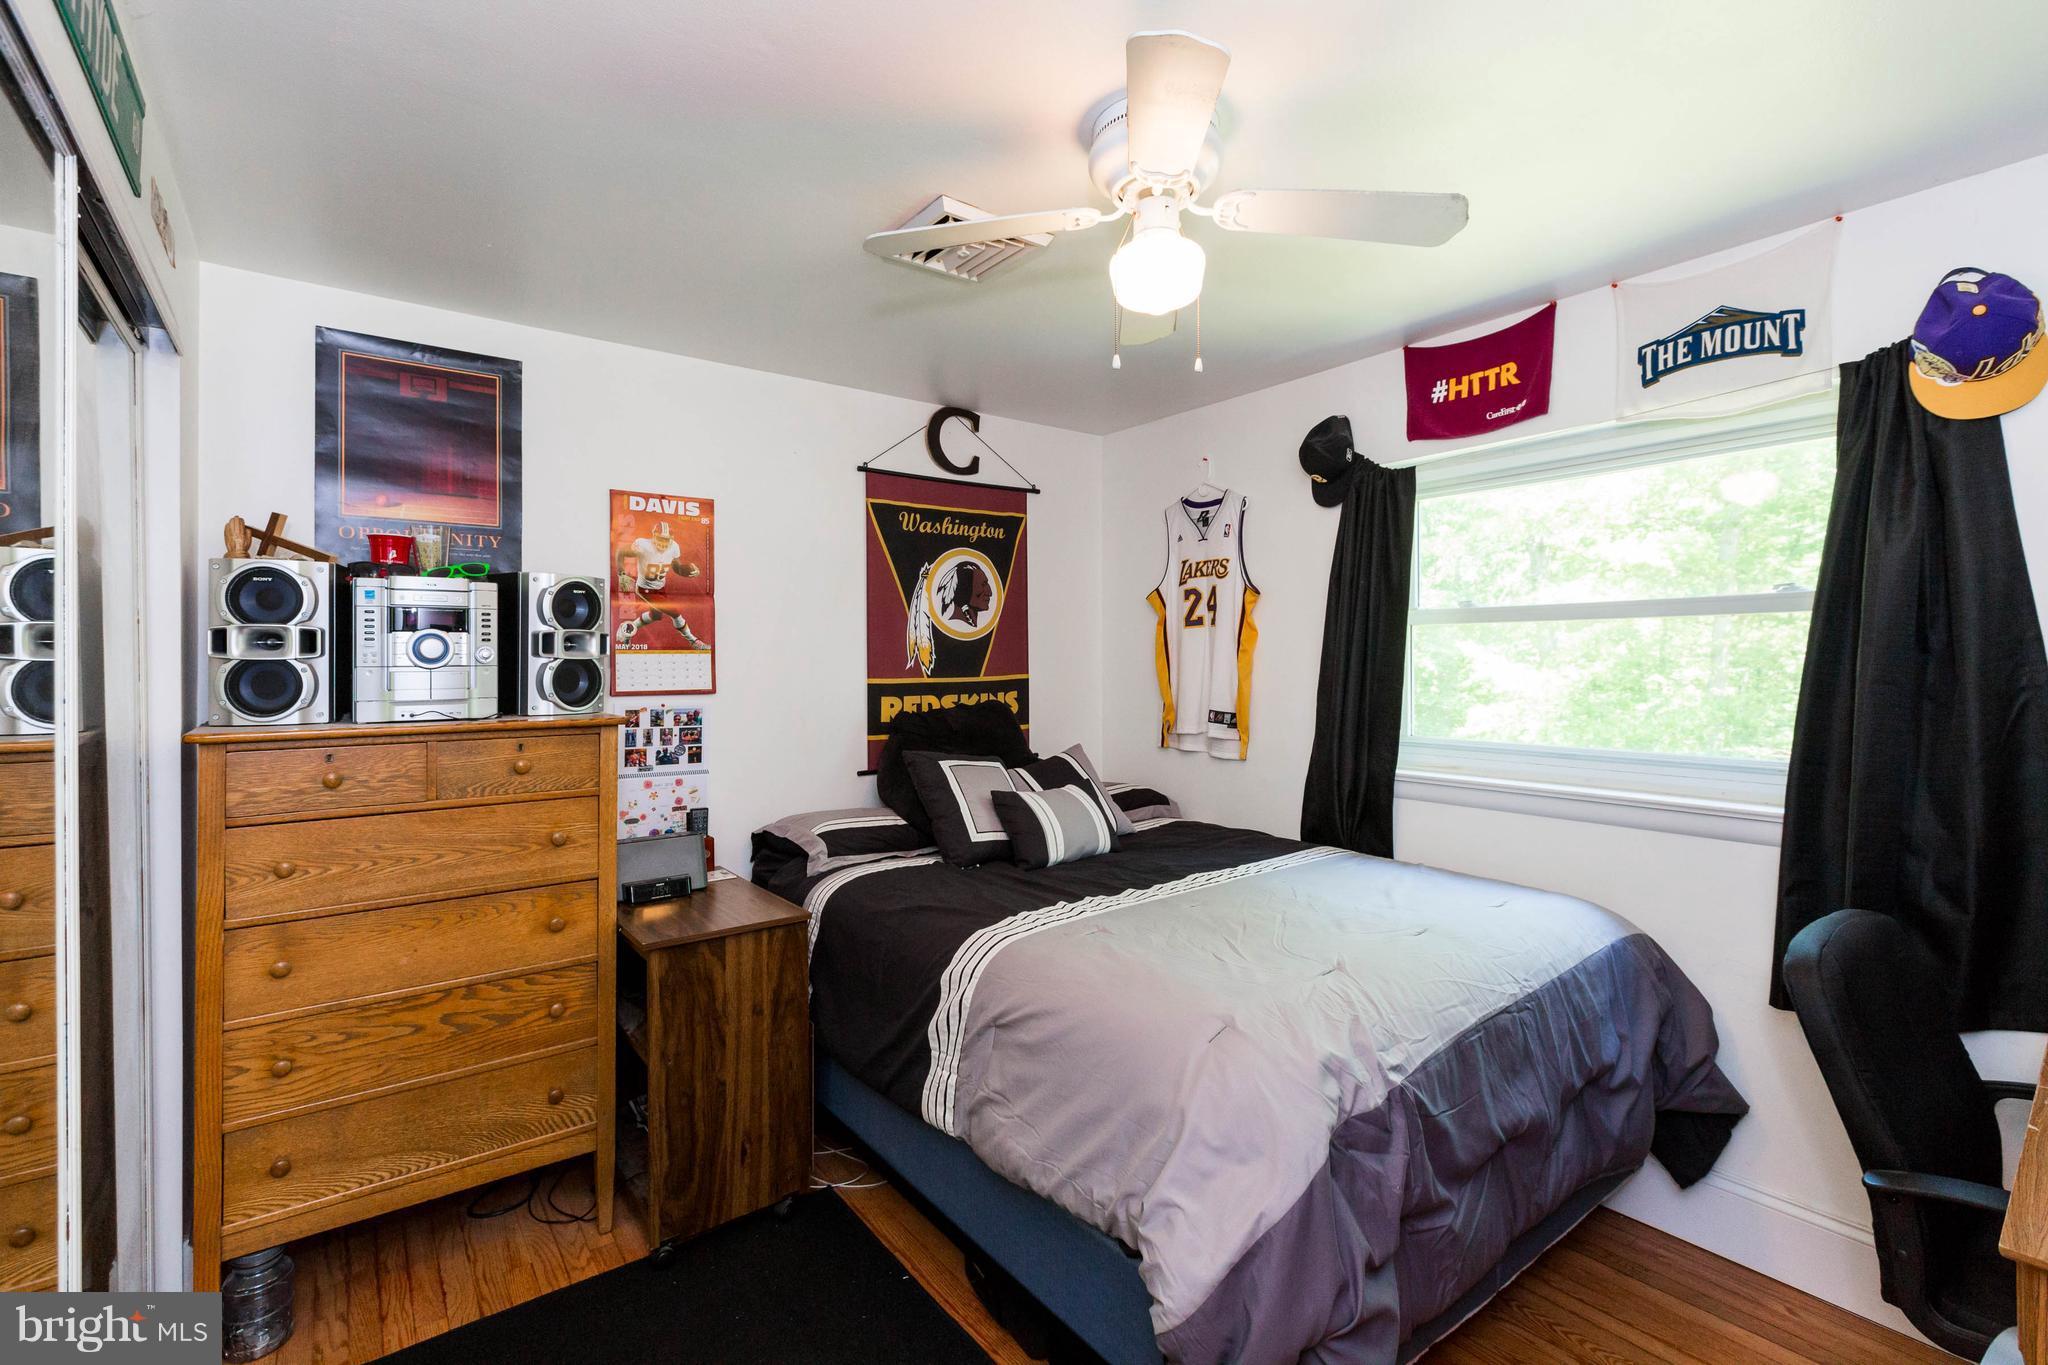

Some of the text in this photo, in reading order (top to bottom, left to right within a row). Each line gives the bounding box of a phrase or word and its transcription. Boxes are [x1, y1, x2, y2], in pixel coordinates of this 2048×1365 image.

[1640, 311, 1803, 383] THE MOUNT
[1431, 361, 1521, 404] #HTTR
[926, 406, 981, 476] C
[629, 495, 700, 517] DAVIS
[898, 511, 1006, 543] Washington
[1179, 558, 1231, 587] LAKERS
[1184, 584, 1218, 628] 24
